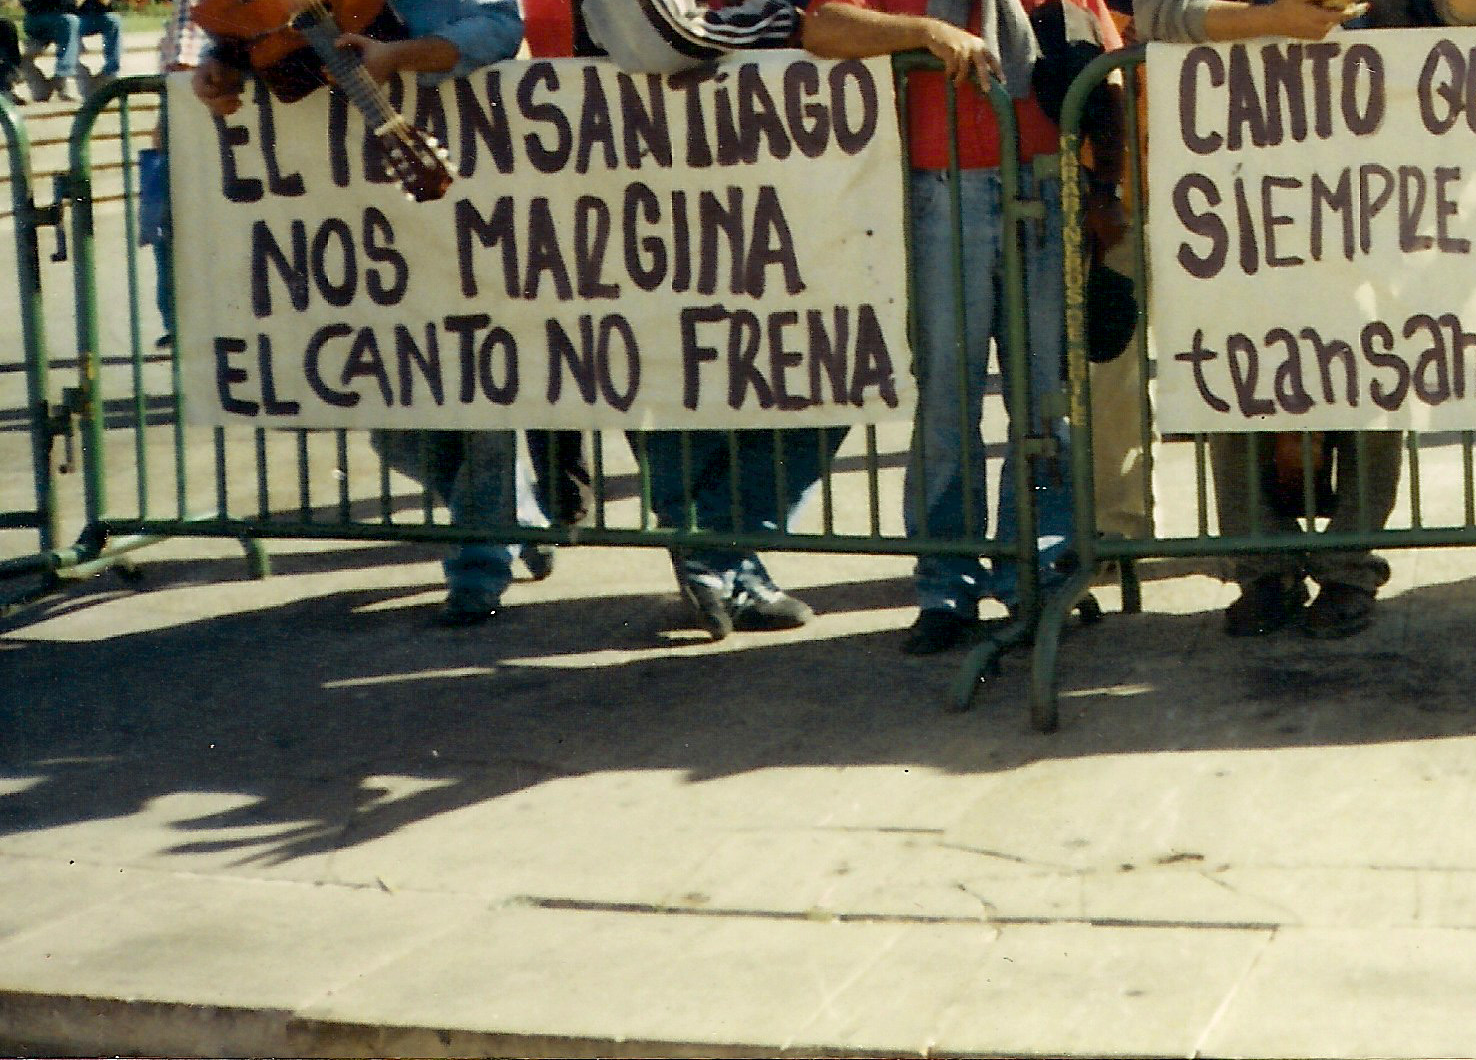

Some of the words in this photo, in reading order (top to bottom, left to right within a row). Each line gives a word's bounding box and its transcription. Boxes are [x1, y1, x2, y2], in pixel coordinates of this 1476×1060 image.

[212, 79, 307, 203] EL
[1178, 42, 1387, 155] CANTO
[250, 207, 410, 318] NOS
[453, 181, 807, 301] MARGINA
[213, 333, 301, 417] EL
[304, 313, 520, 408] CANTO
[545, 313, 641, 413] NO
[679, 302, 900, 412] FRENA
